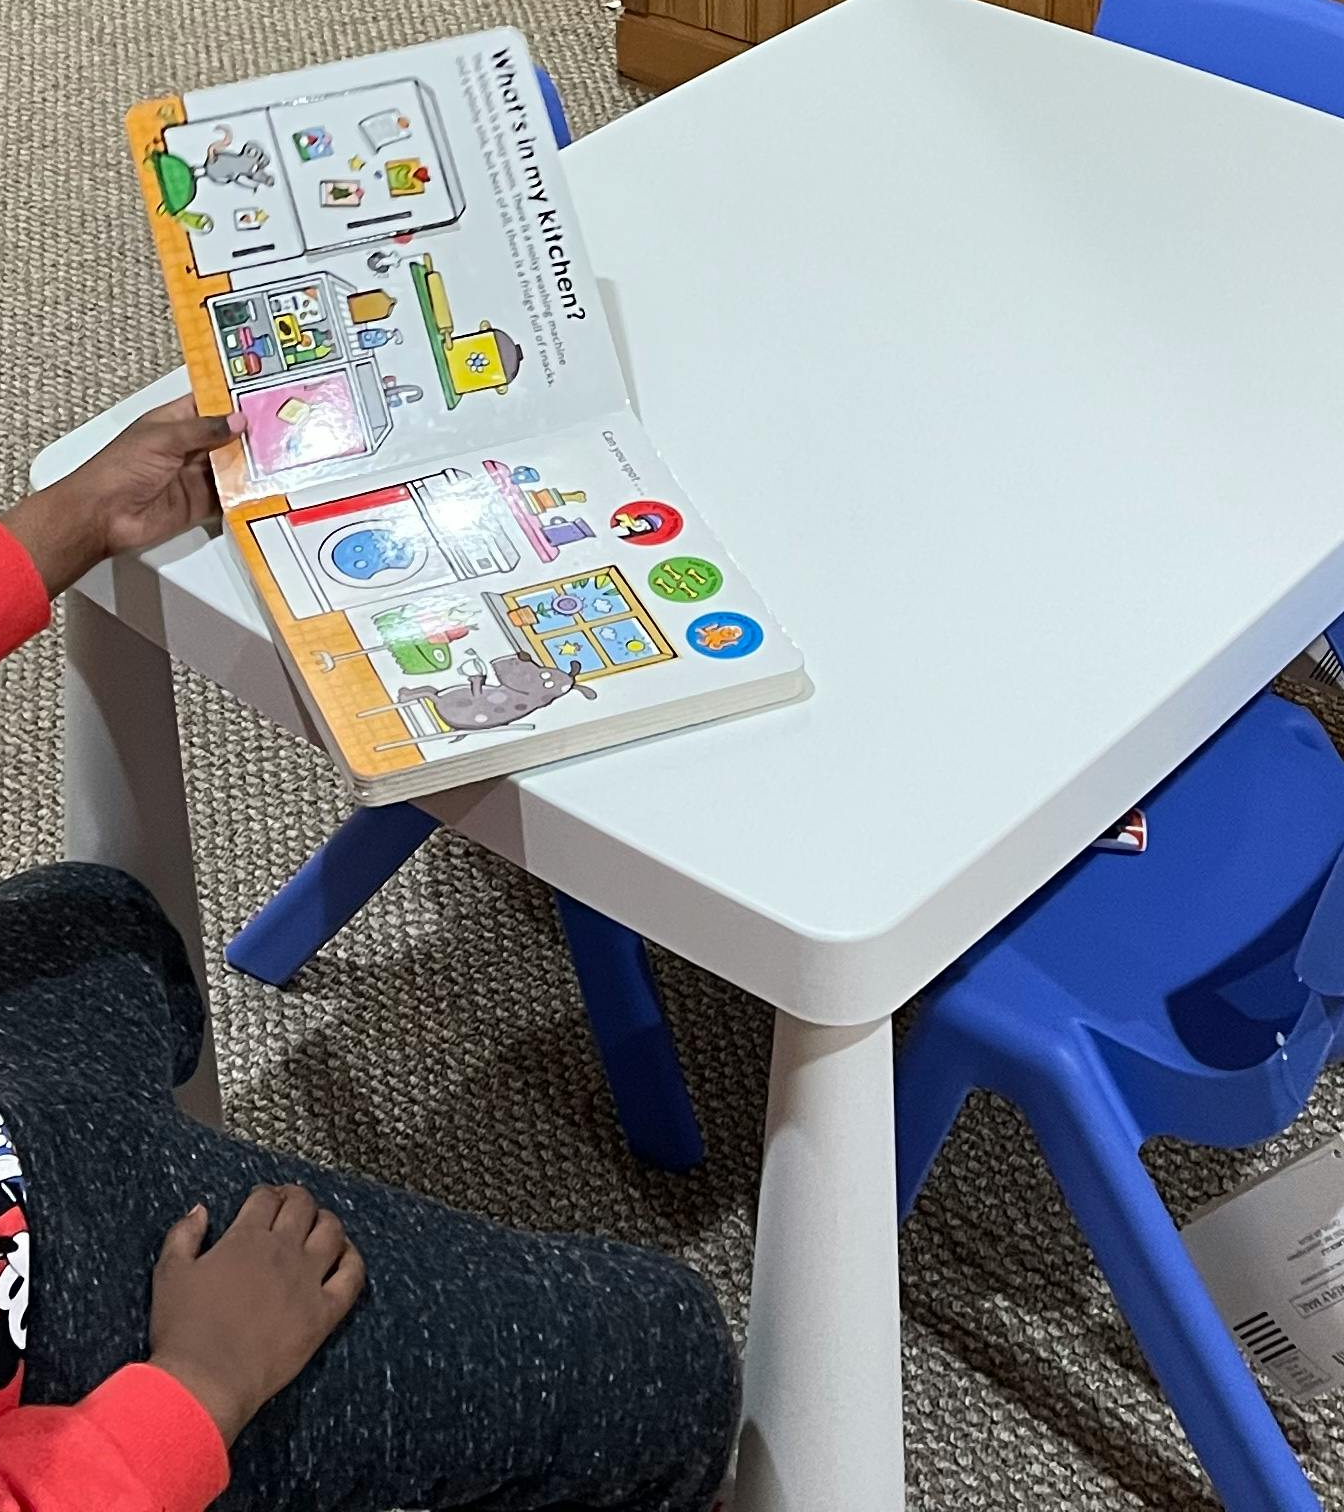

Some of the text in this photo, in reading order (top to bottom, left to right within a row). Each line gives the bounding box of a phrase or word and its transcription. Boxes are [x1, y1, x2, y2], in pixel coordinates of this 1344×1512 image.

[493, 49, 585, 319] What's in my kitchen?
[520, 280, 534, 311] fridge
[530, 314, 542, 332] full
[536, 274, 552, 318] washing
[549, 321, 566, 365] machine
[535, 335, 547, 346] of
[540, 350, 554, 387] snacks.
[602, 431, 640, 481] Can you spot
